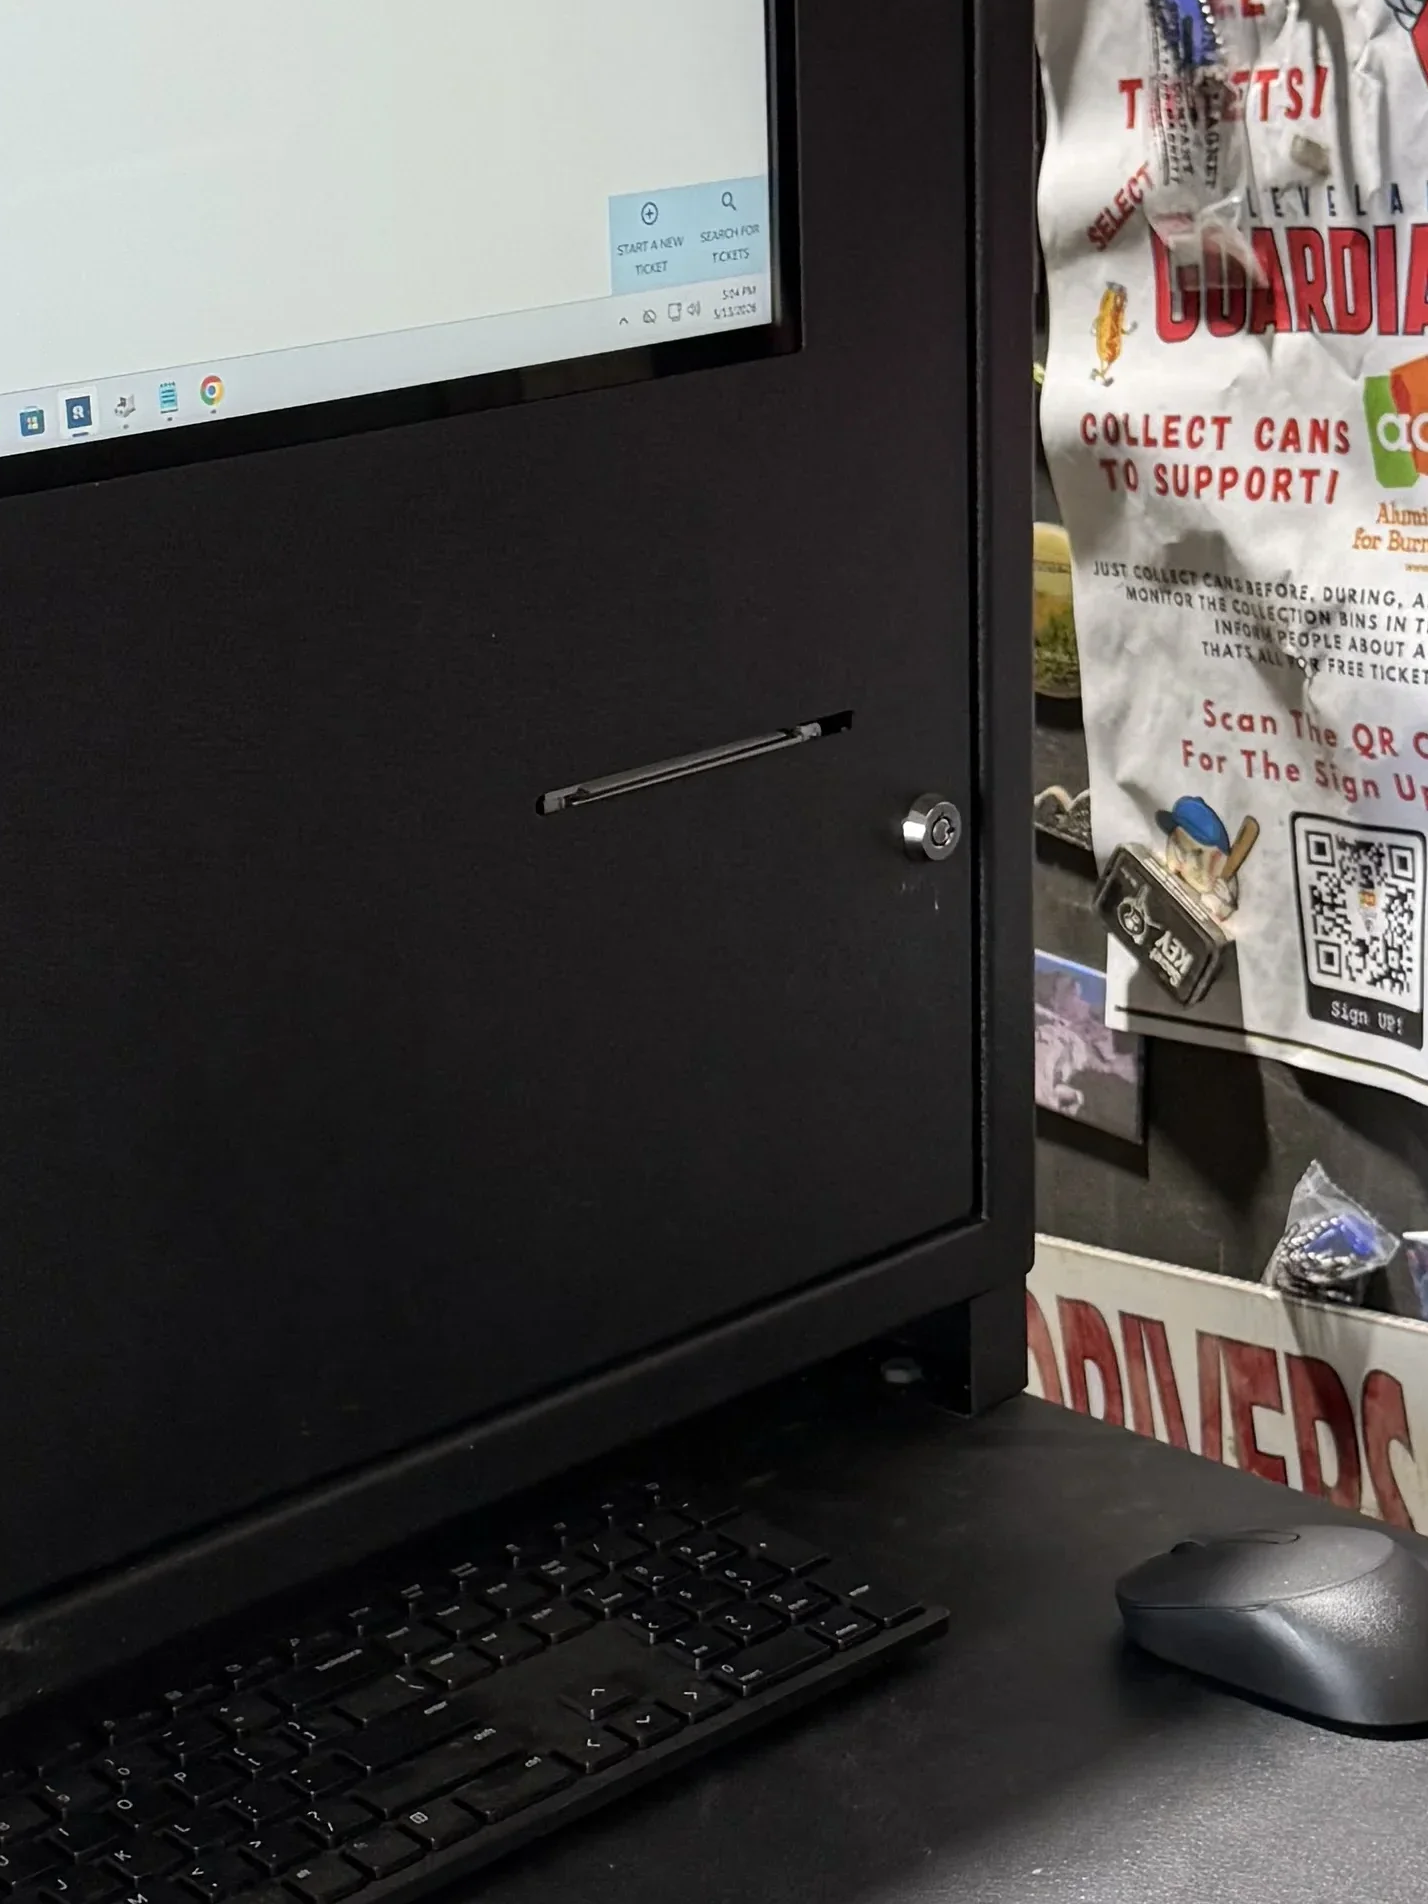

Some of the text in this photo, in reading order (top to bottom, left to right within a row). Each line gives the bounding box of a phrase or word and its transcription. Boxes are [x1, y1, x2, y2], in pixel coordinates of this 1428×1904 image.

[617, 236, 684, 256] START A NEW
[741, 224, 760, 237] FOR
[636, 261, 668, 275] TICKET
[1079, 412, 1352, 454] COLLECT CANS
[1100, 461, 1341, 506] TO SUPPORT!
[1352, 527, 1381, 550] for
[1092, 561, 1128, 577] JUST
[1133, 564, 1198, 586] COLLECT
[1202, 572, 1244, 595] CANS
[1246, 580, 1314, 603] BEFORE,
[1322, 585, 1402, 609] DURING,
[1126, 586, 1193, 609] MONITOR
[1198, 593, 1228, 612] THE
[1232, 598, 1332, 627] COLLECTION
[1339, 610, 1378, 630] BINS
[1387, 616, 1406, 633] IN
[1215, 619, 1272, 643] INFORM
[1278, 629, 1342, 651] PEOPLE
[1348, 637, 1405, 659] ABOUT
[1259, 647, 1285, 667] ALL
[1327, 658, 1365, 678] FREE
[1203, 699, 1278, 736] Scan
[1289, 710, 1338, 749] The
[1351, 723, 1398, 759] QR
[1181, 739, 1228, 776] For
[1240, 748, 1301, 783] The
[1314, 759, 1380, 805] Sign
[1330, 999, 1405, 1036] Sign UP!
